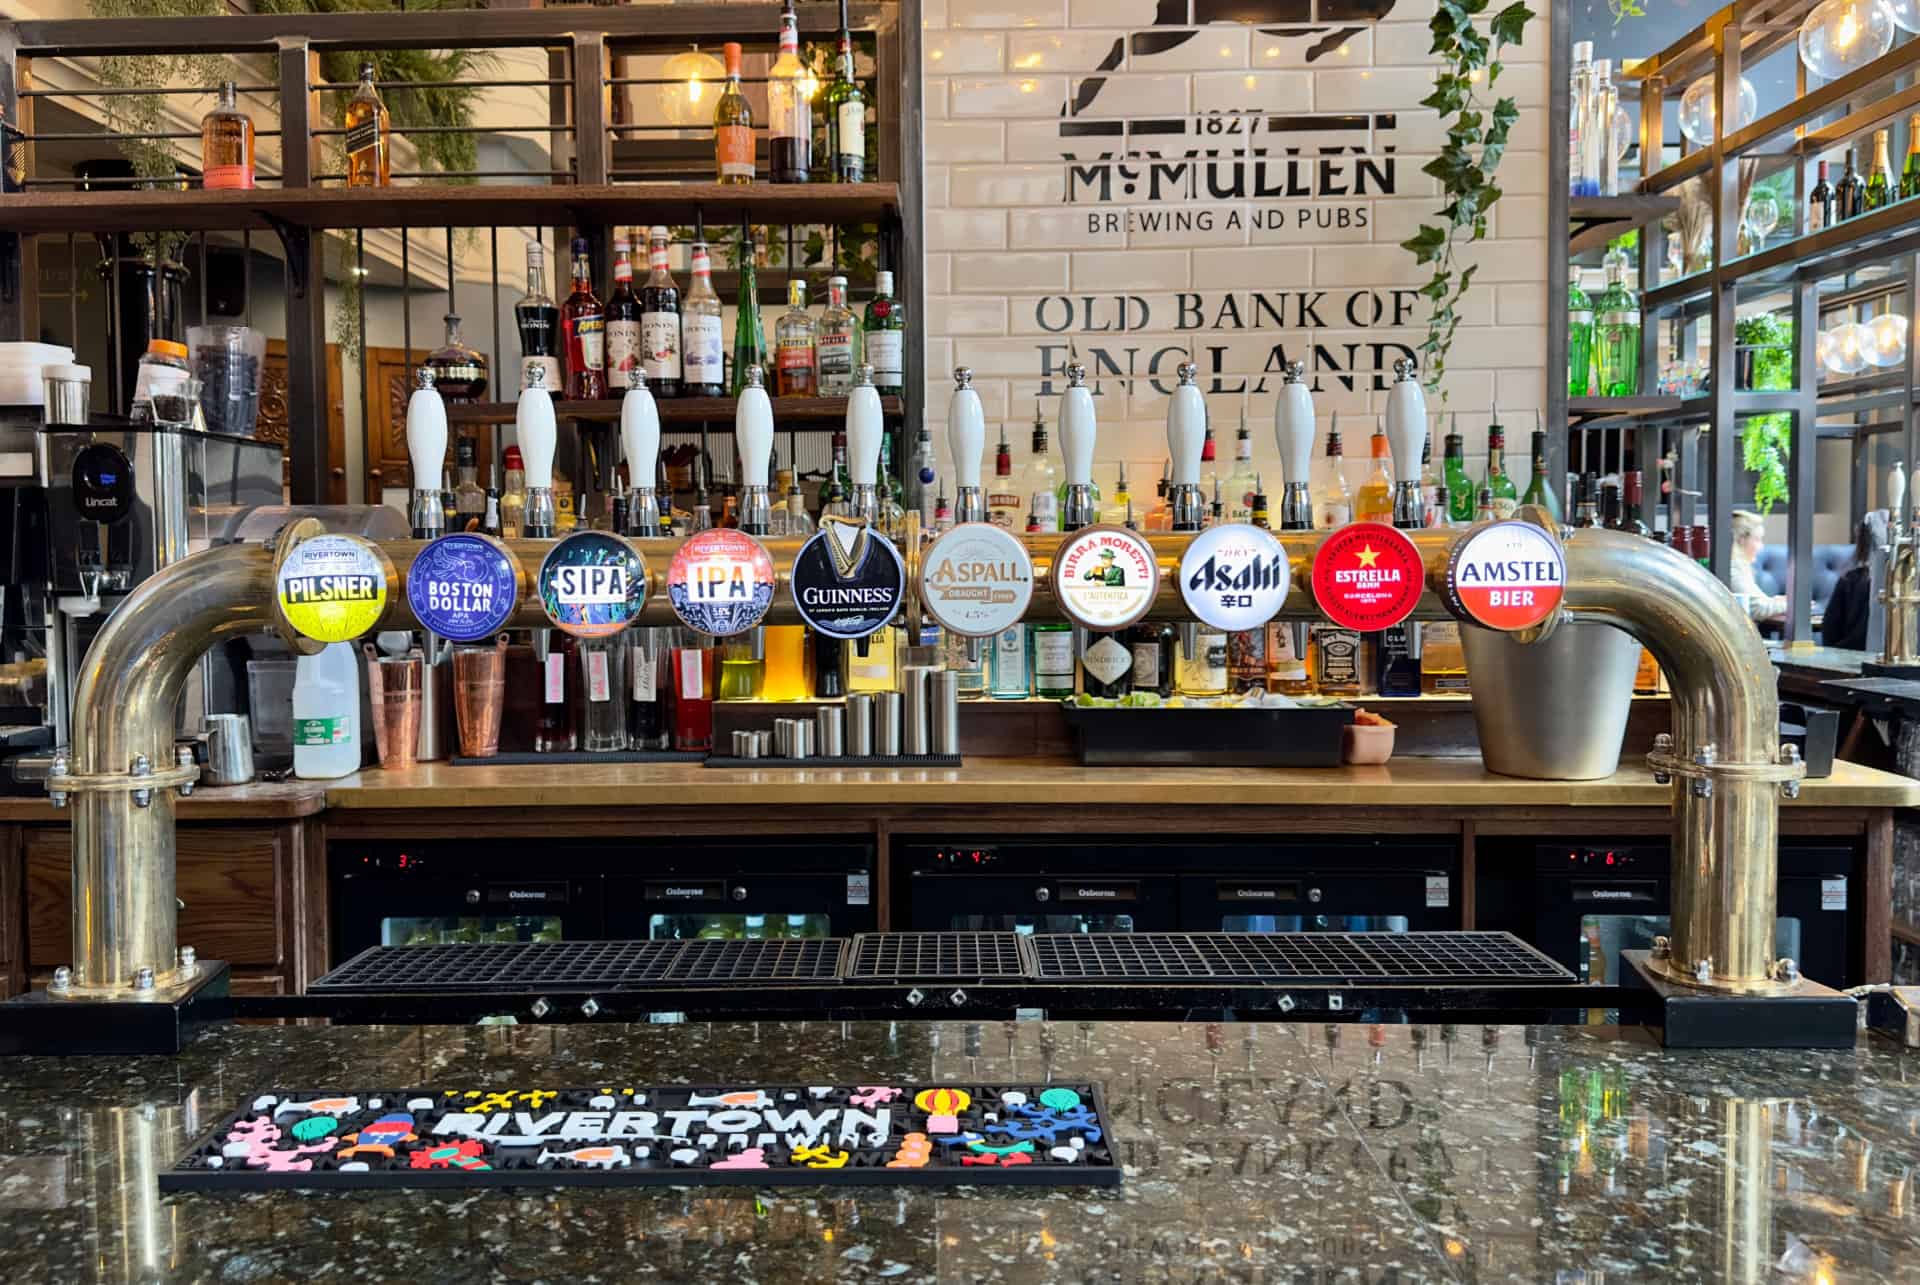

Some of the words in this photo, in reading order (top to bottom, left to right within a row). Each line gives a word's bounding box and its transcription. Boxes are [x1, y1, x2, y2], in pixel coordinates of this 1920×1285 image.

[1195, 108, 1264, 136] 1827
[1060, 145, 1396, 203] McMULLEN
[1088, 210, 1214, 234] BREWING
[1226, 209, 1285, 232] AND
[1297, 207, 1368, 229] PUBS
[1035, 295, 1150, 333] OLD
[1174, 291, 1328, 331] BANK
[1345, 289, 1420, 327] OF
[1035, 343, 1419, 397] ENGLAND
[85, 496, 118, 507] Lincat
[936, 557, 1021, 583] ASPALL
[1064, 540, 1097, 578] BIRRA
[1100, 537, 1149, 579] MORETTI
[1461, 560, 1560, 582] AMSTEL
[562, 568, 623, 595] SIPA
[697, 566, 747, 598] IPA
[1189, 553, 1281, 591] Asahi
[1335, 569, 1401, 583] ESTRELLA
[289, 575, 373, 603] PILSNER
[428, 580, 493, 598] BOSTON
[803, 587, 892, 605] GUINNESS
[1220, 594, 1253, 608] 辛口
[1489, 590, 1535, 607] BIER
[429, 596, 492, 612] DOLLAR
[432, 1107, 891, 1139] RIVERTOWN
